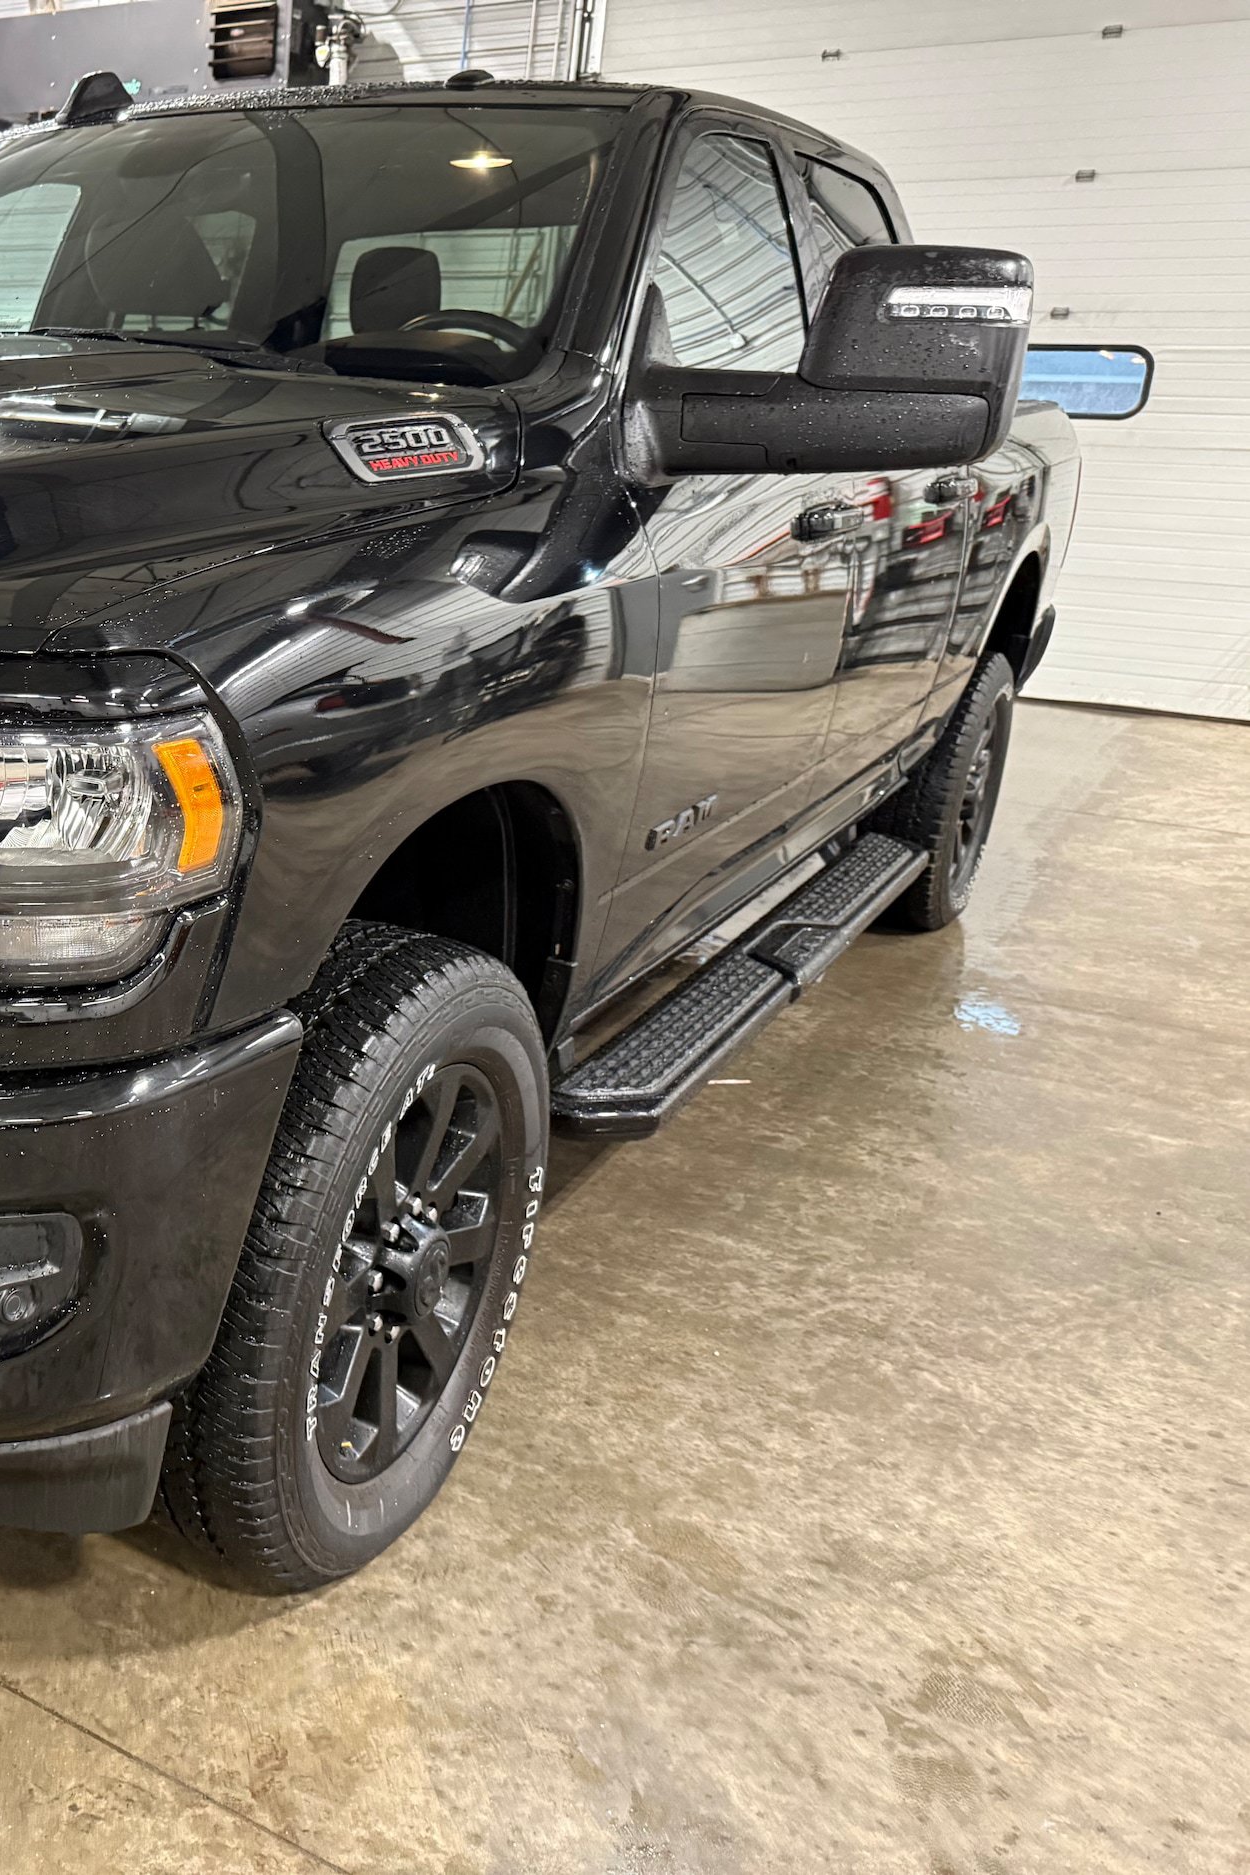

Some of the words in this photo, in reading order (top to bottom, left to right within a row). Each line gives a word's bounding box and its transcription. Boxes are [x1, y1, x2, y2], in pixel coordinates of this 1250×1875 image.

[355, 427, 451, 454] 2500
[368, 455, 420, 472] HEAVY
[421, 450, 460, 466] DUTY
[644, 793, 718, 851] RAM
[305, 1120, 392, 1442] TRANSFORCE
